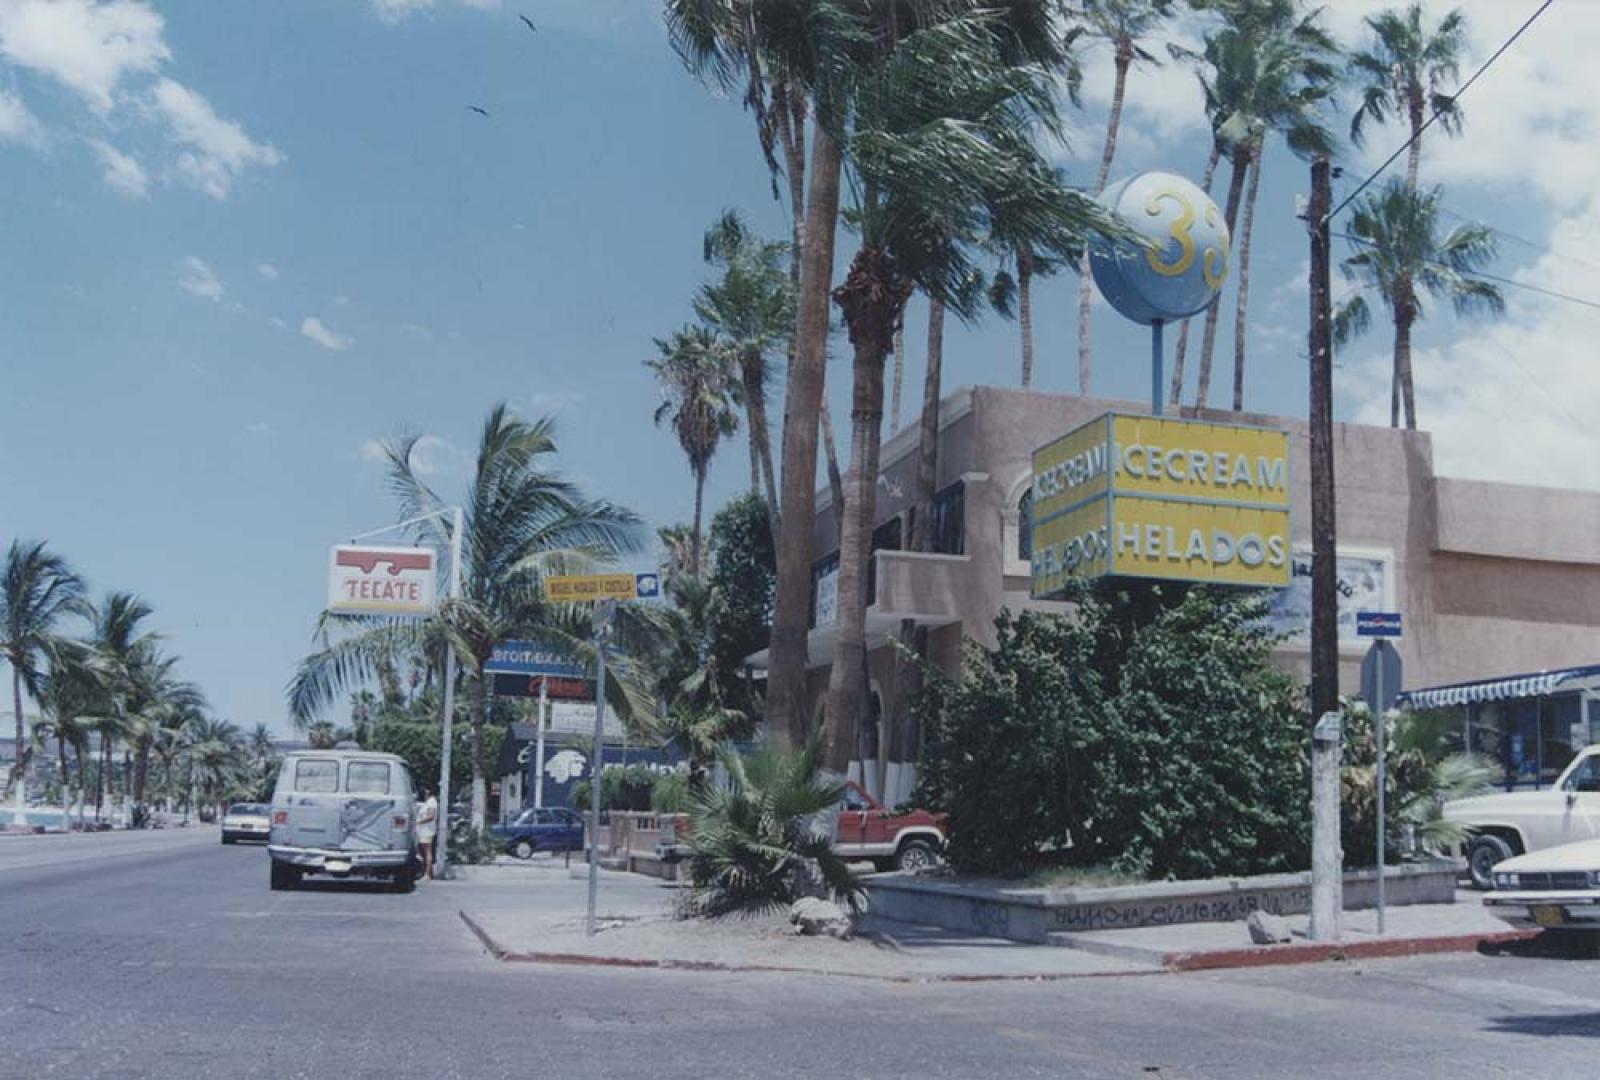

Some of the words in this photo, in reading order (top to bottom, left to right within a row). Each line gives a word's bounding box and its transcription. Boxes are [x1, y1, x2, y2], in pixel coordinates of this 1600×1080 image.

[1113, 442, 1286, 491] ICECREAM
[1116, 522, 1286, 567] HELADOS
[346, 578, 421, 601] TECATE
